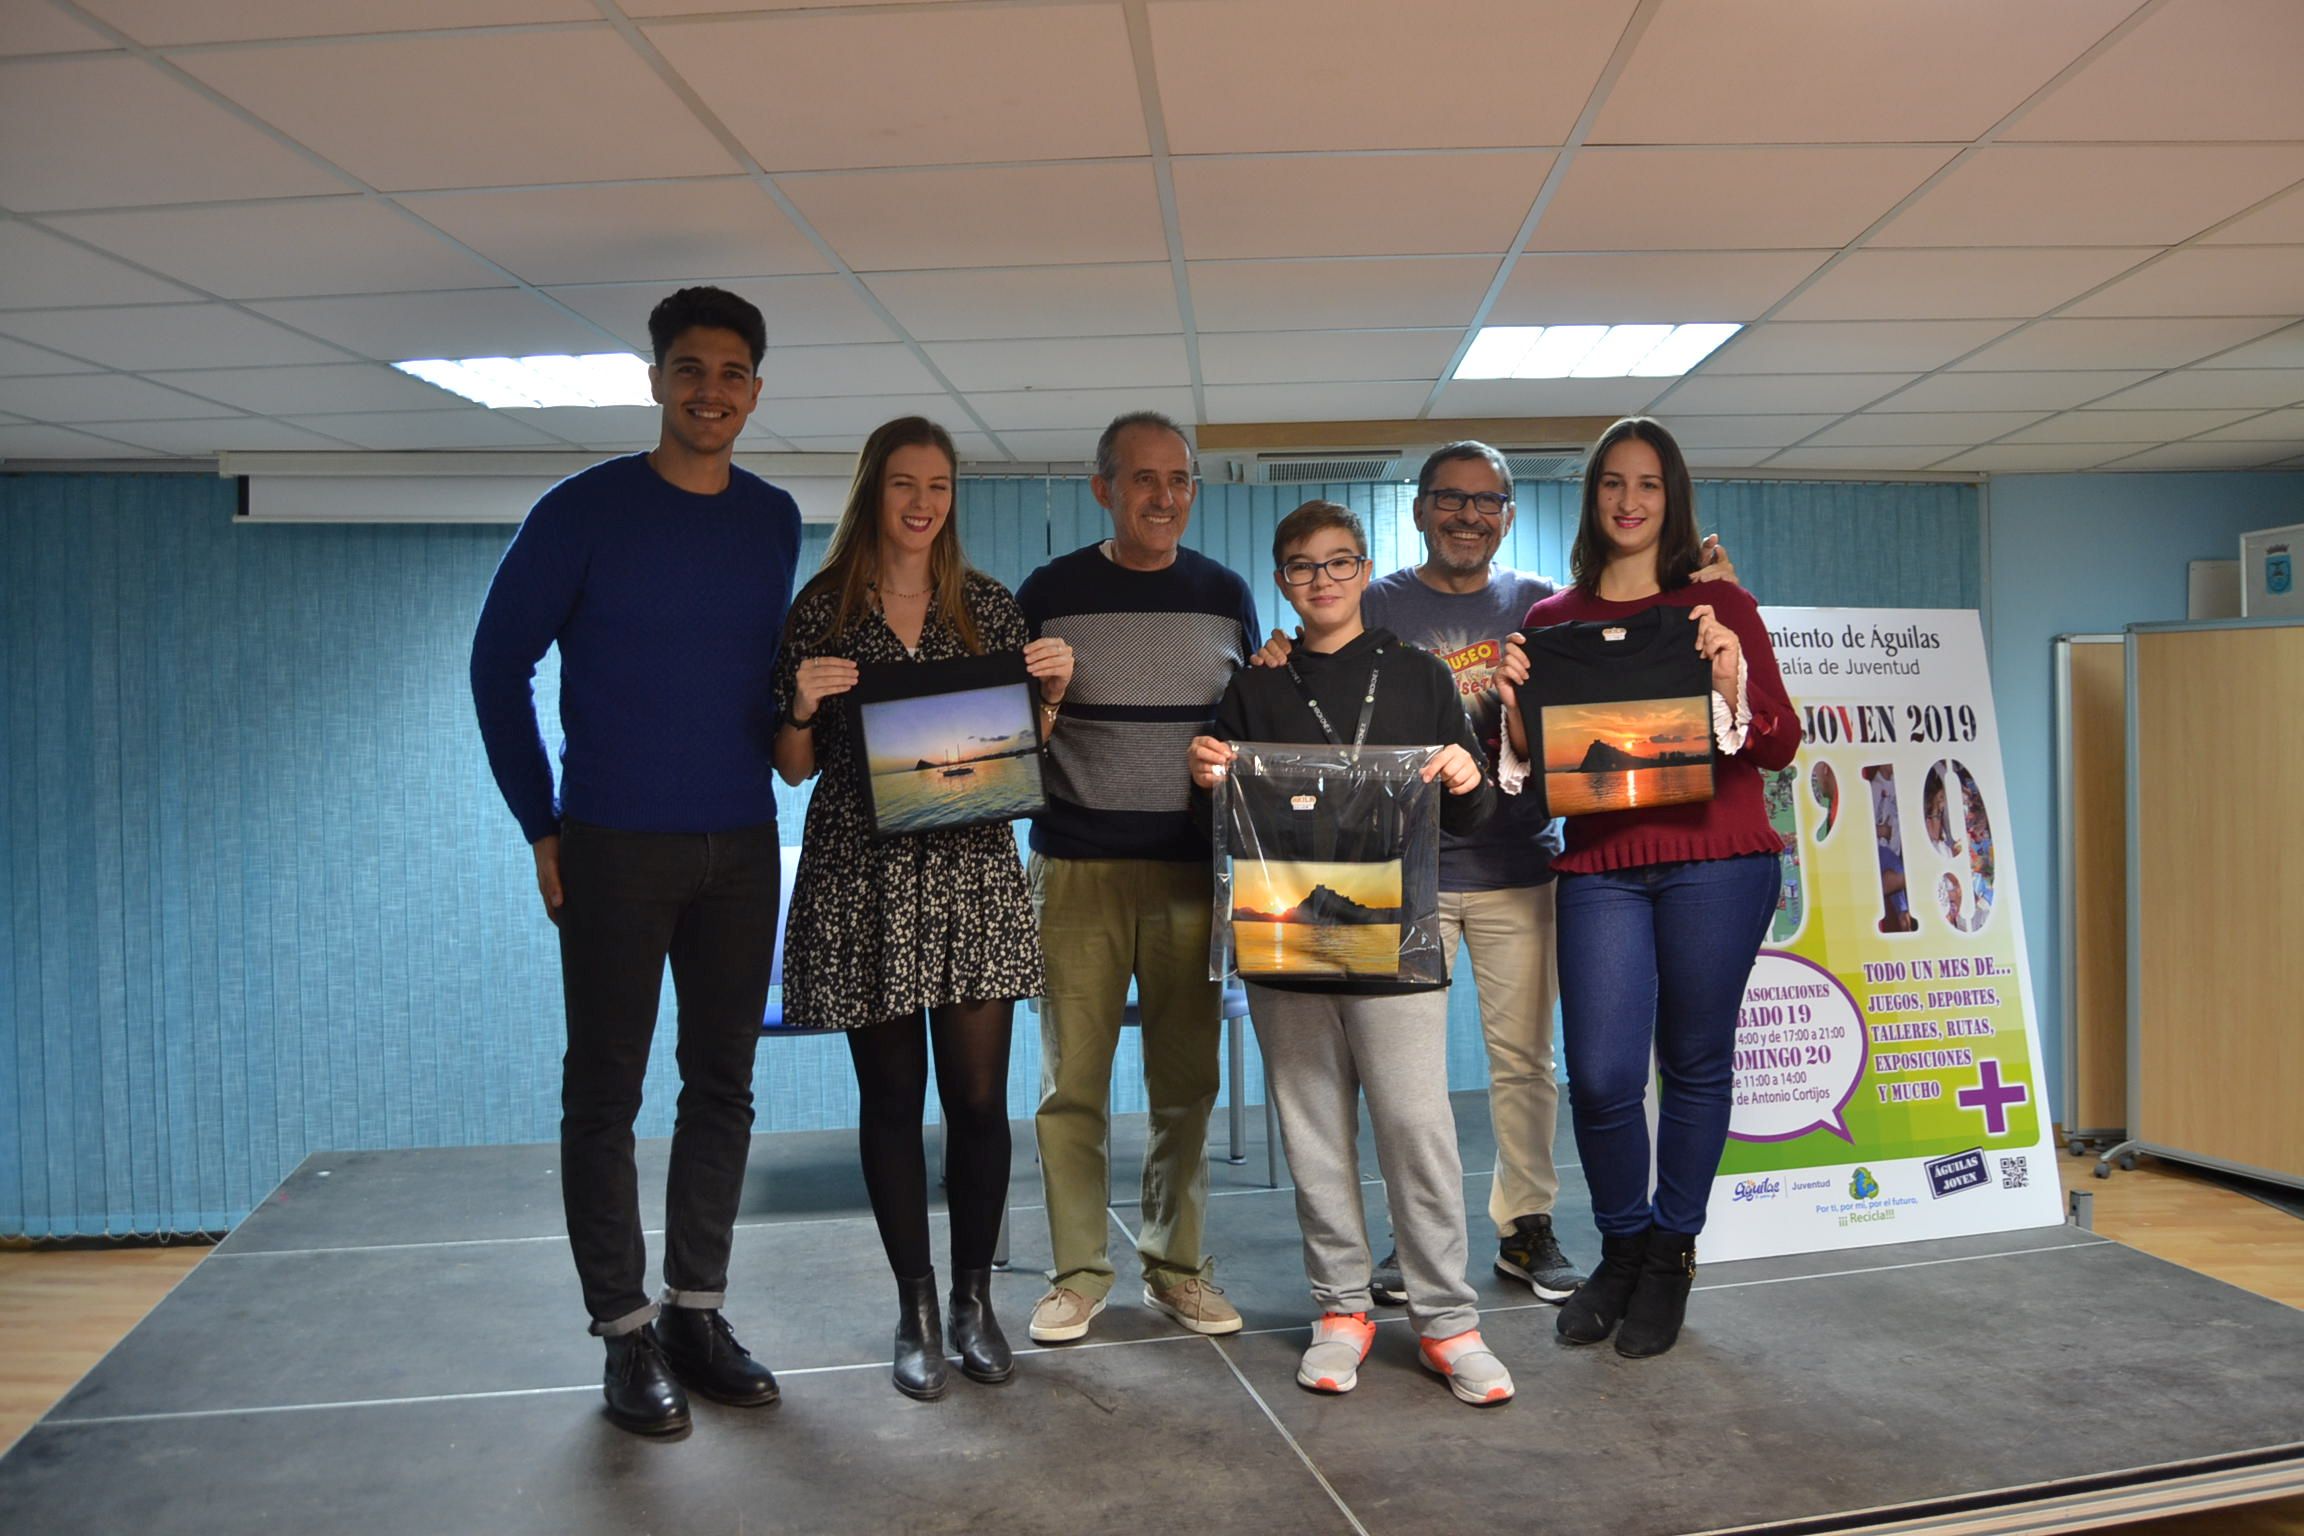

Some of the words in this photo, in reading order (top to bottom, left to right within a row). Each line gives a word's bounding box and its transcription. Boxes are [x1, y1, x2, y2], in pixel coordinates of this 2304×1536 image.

[1842, 624, 1865, 648] de
[1871, 624, 1940, 657] Águilas
[1448, 644, 1492, 670] USEO
[1819, 658, 1839, 675] de
[1845, 659, 1920, 675] Juventud
[1801, 705, 1897, 744] JOVEN
[1907, 704, 1977, 743] 2019
[1864, 961, 1906, 983] TODO
[1911, 960, 1933, 980] UN
[1939, 958, 1970, 978] MES
[1974, 956, 2011, 976] DE...
[1746, 984, 1830, 1002] ASOCIACIONES
[1868, 993, 1924, 1012] JUEGOS,
[1928, 988, 2000, 1008] DEPORTES,
[1736, 1005, 1783, 1028] BADO
[1788, 1004, 1811, 1024] 19
[1737, 1032, 1759, 1045] 4:00
[1760, 1034, 1767, 1047] y
[1768, 1030, 1781, 1043] de
[1783, 1029, 1809, 1042] 17:00
[1811, 1031, 1817, 1040] a
[1819, 1026, 1845, 1040] 21:00
[1871, 1022, 1943, 1042] TALLERES,
[1946, 1018, 1994, 1037] RUTAS,
[1732, 1046, 1802, 1071] OMINGO
[1805, 1045, 1831, 1064] 20
[1875, 1049, 1972, 1072] EXPOSICIONES
[1744, 1074, 1771, 1087] 11:00
[1772, 1076, 1778, 1085] a
[1781, 1071, 1807, 1085] 14:00
[1736, 1092, 1749, 1105] de
[1751, 1088, 1790, 1104] Antonio
[1792, 1086, 1830, 1103] Cortijos
[1878, 1085, 1887, 1101] Y
[1892, 1081, 1940, 1100] MUCHO
[1934, 1156, 1979, 1178] ÁGUILAS
[1792, 1179, 1831, 1191] Juventud
[1943, 1171, 1978, 1190] JOVEN
[1816, 1204, 1829, 1214] Por
